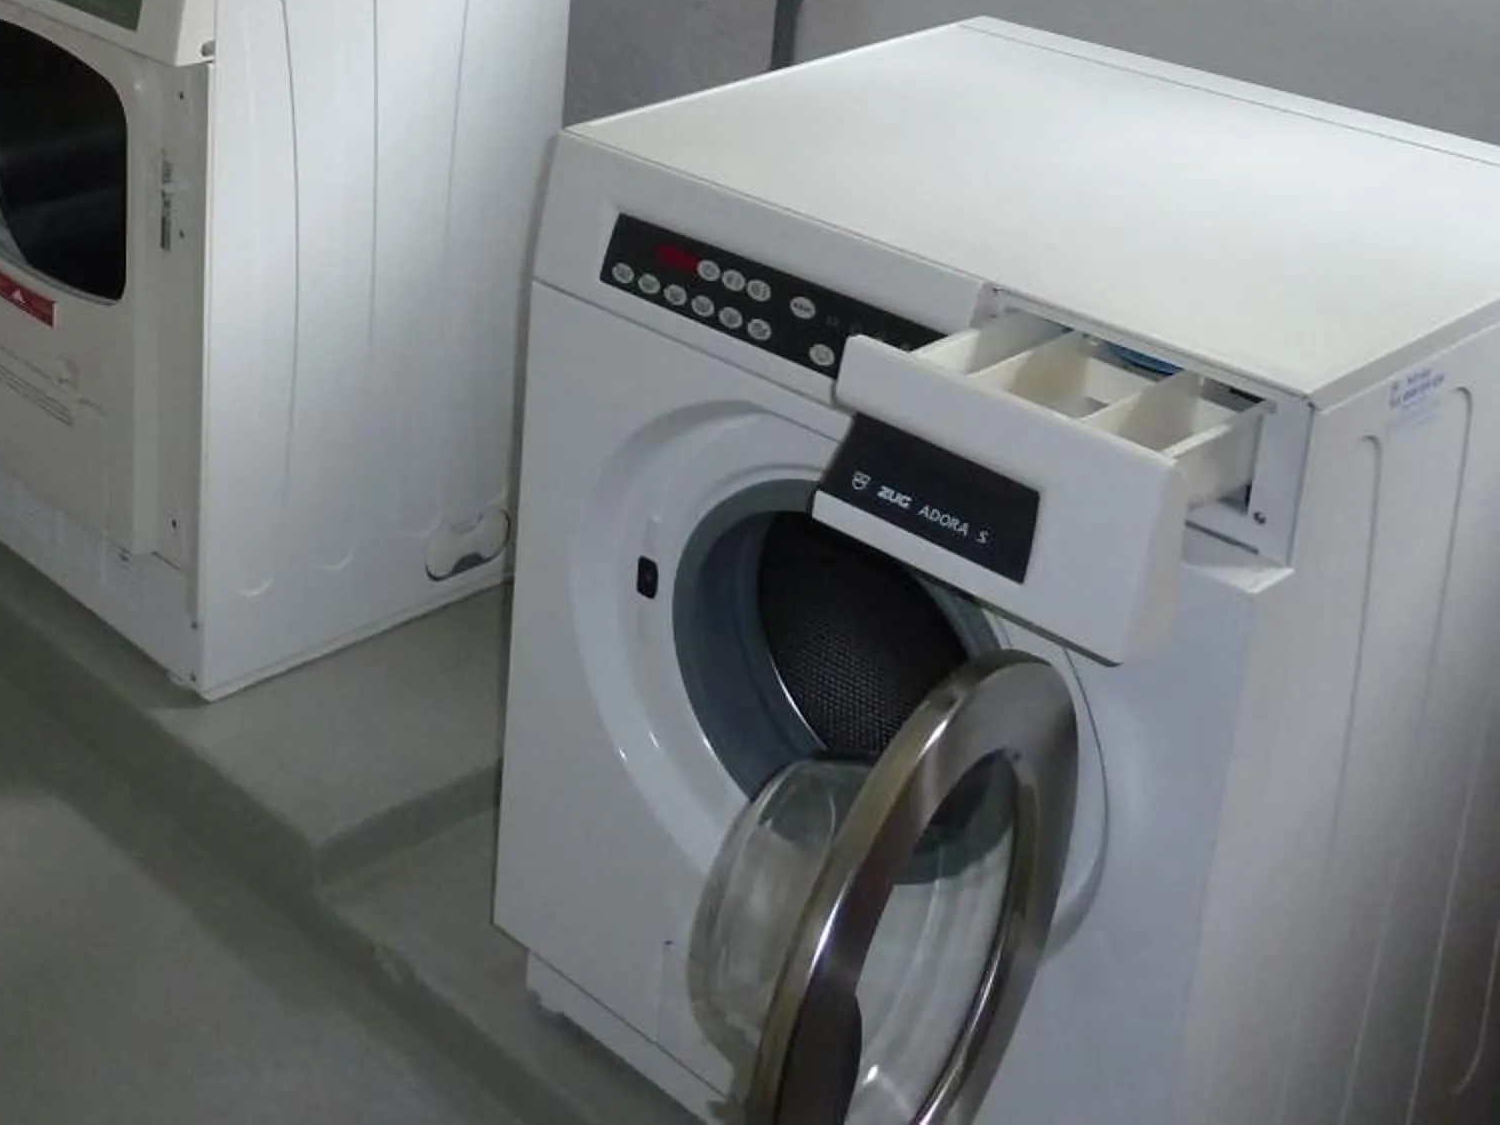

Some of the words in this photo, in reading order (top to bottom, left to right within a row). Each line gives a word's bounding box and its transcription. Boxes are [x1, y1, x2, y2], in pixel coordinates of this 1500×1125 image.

[877, 485, 912, 508] ZUG
[918, 505, 969, 536] ADORA
[976, 530, 989, 543] S
